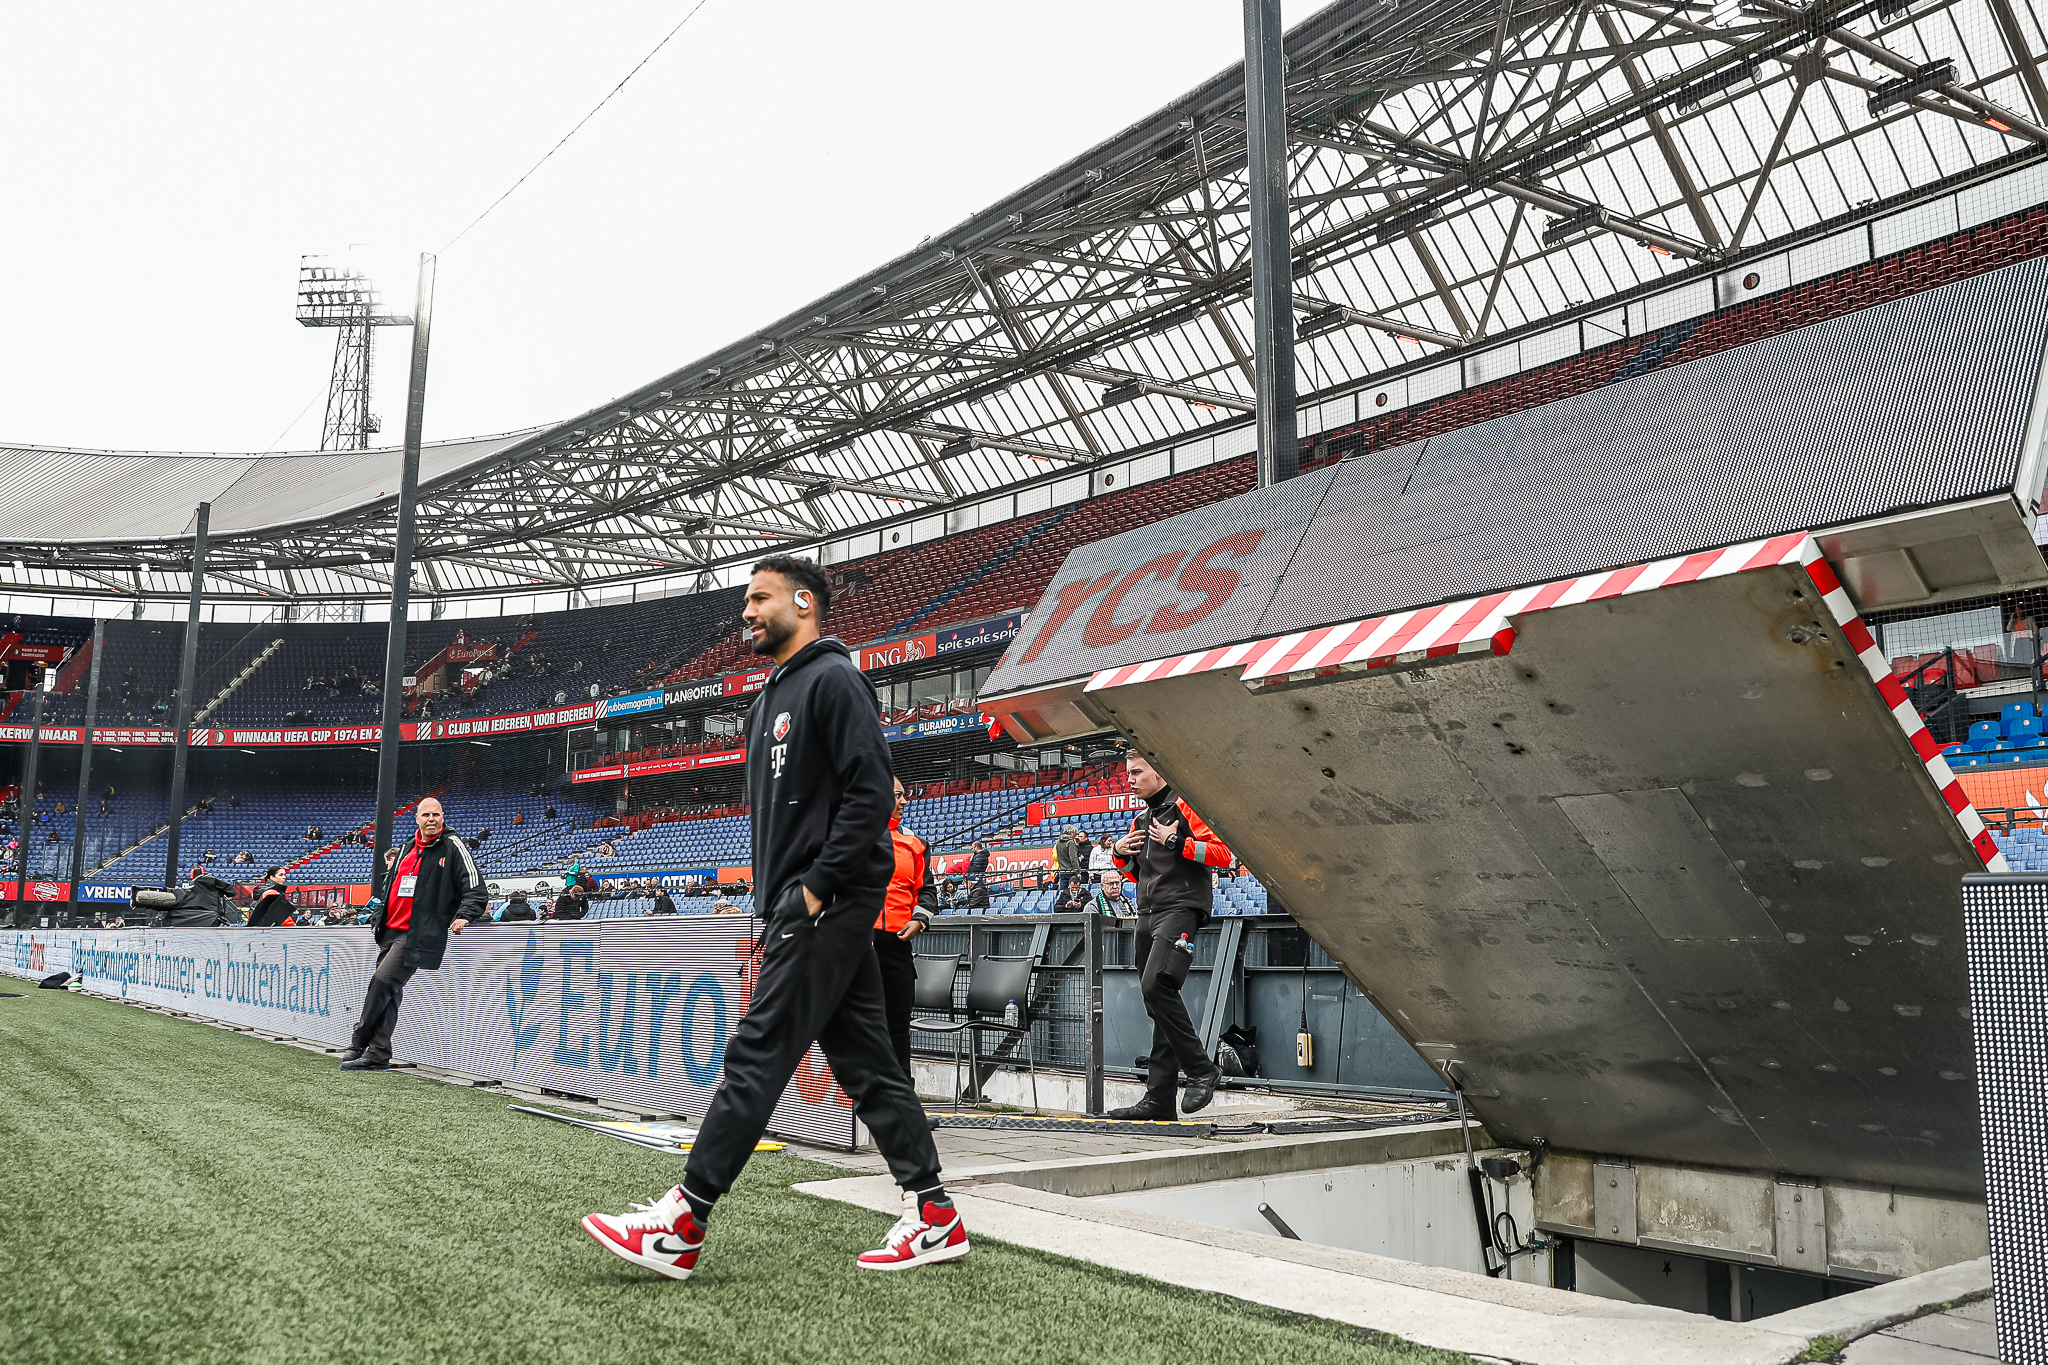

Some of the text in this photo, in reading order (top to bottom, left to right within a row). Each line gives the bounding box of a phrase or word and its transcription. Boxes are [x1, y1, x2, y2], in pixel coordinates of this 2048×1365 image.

[994, 529, 1265, 669] rcs
[938, 628, 1019, 653] SPIE SPIE SPIE
[868, 648, 901, 670] ING
[607, 693, 663, 713] rubbermagazijn.nl
[664, 683, 723, 705] PLAN@OFFICE
[448, 705, 594, 736] CLUB VAN IEDEREEN, VOOR IEDEREEN
[918, 718, 958, 732] BURANDO
[0, 728, 78, 741] KERWNNAAR
[233, 731, 282, 744] WINNAAR
[284, 731, 308, 743] UEFA
[311, 730, 331, 742] CUP
[333, 729, 358, 741] 1974
[359, 729, 373, 740] EN
[1108, 796, 1126, 811] UIT
[84, 886, 132, 899] VRIEND
[155, 940, 200, 995] binnen-
[204, 958, 222, 998] en
[226, 943, 331, 1017] buitenland
[554, 938, 767, 1088] Euro
